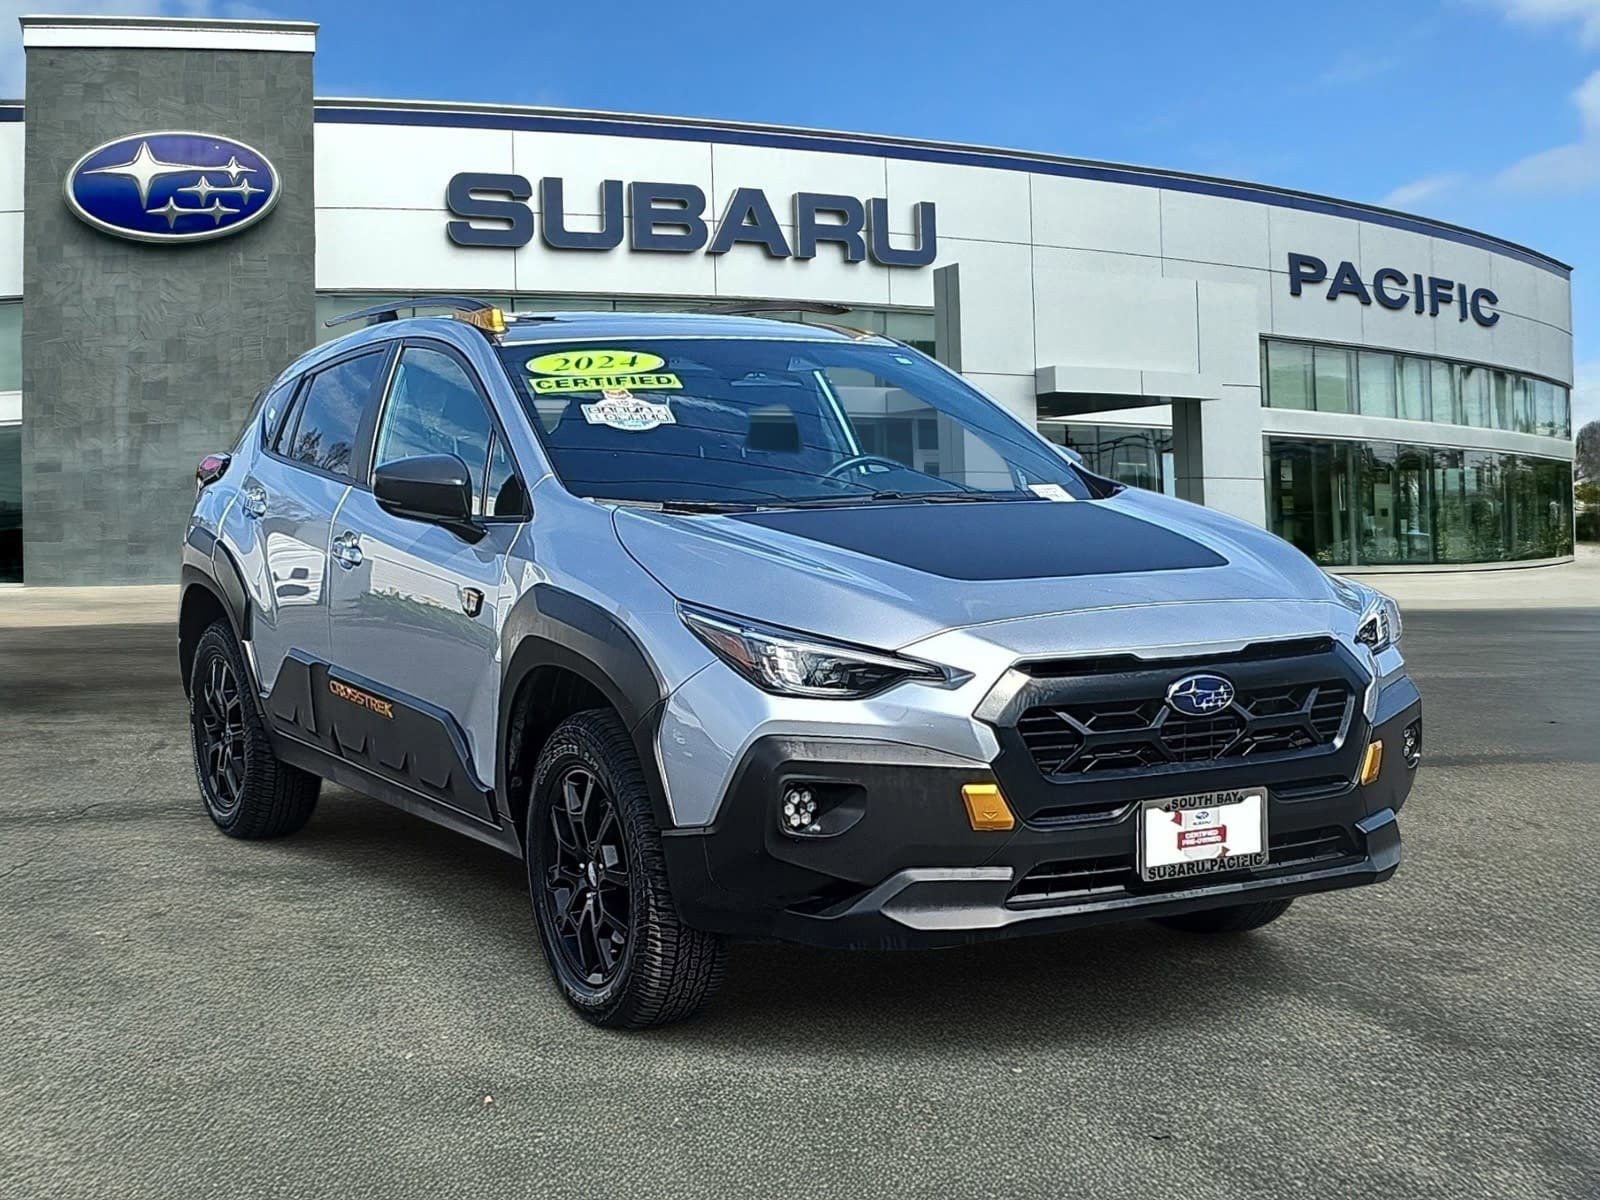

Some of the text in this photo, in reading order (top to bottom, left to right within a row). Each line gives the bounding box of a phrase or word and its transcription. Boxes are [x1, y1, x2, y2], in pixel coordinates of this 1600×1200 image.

[446, 172, 937, 267] SUBARU
[1288, 252, 1500, 327] PACIFIC
[552, 354, 640, 372] 2024
[535, 376, 673, 390] CERTIFIED
[329, 680, 393, 719] CROSSTREK
[1171, 791, 1239, 810] SOUTH BAY
[1148, 853, 1266, 880] SUBARU PACIFIC
